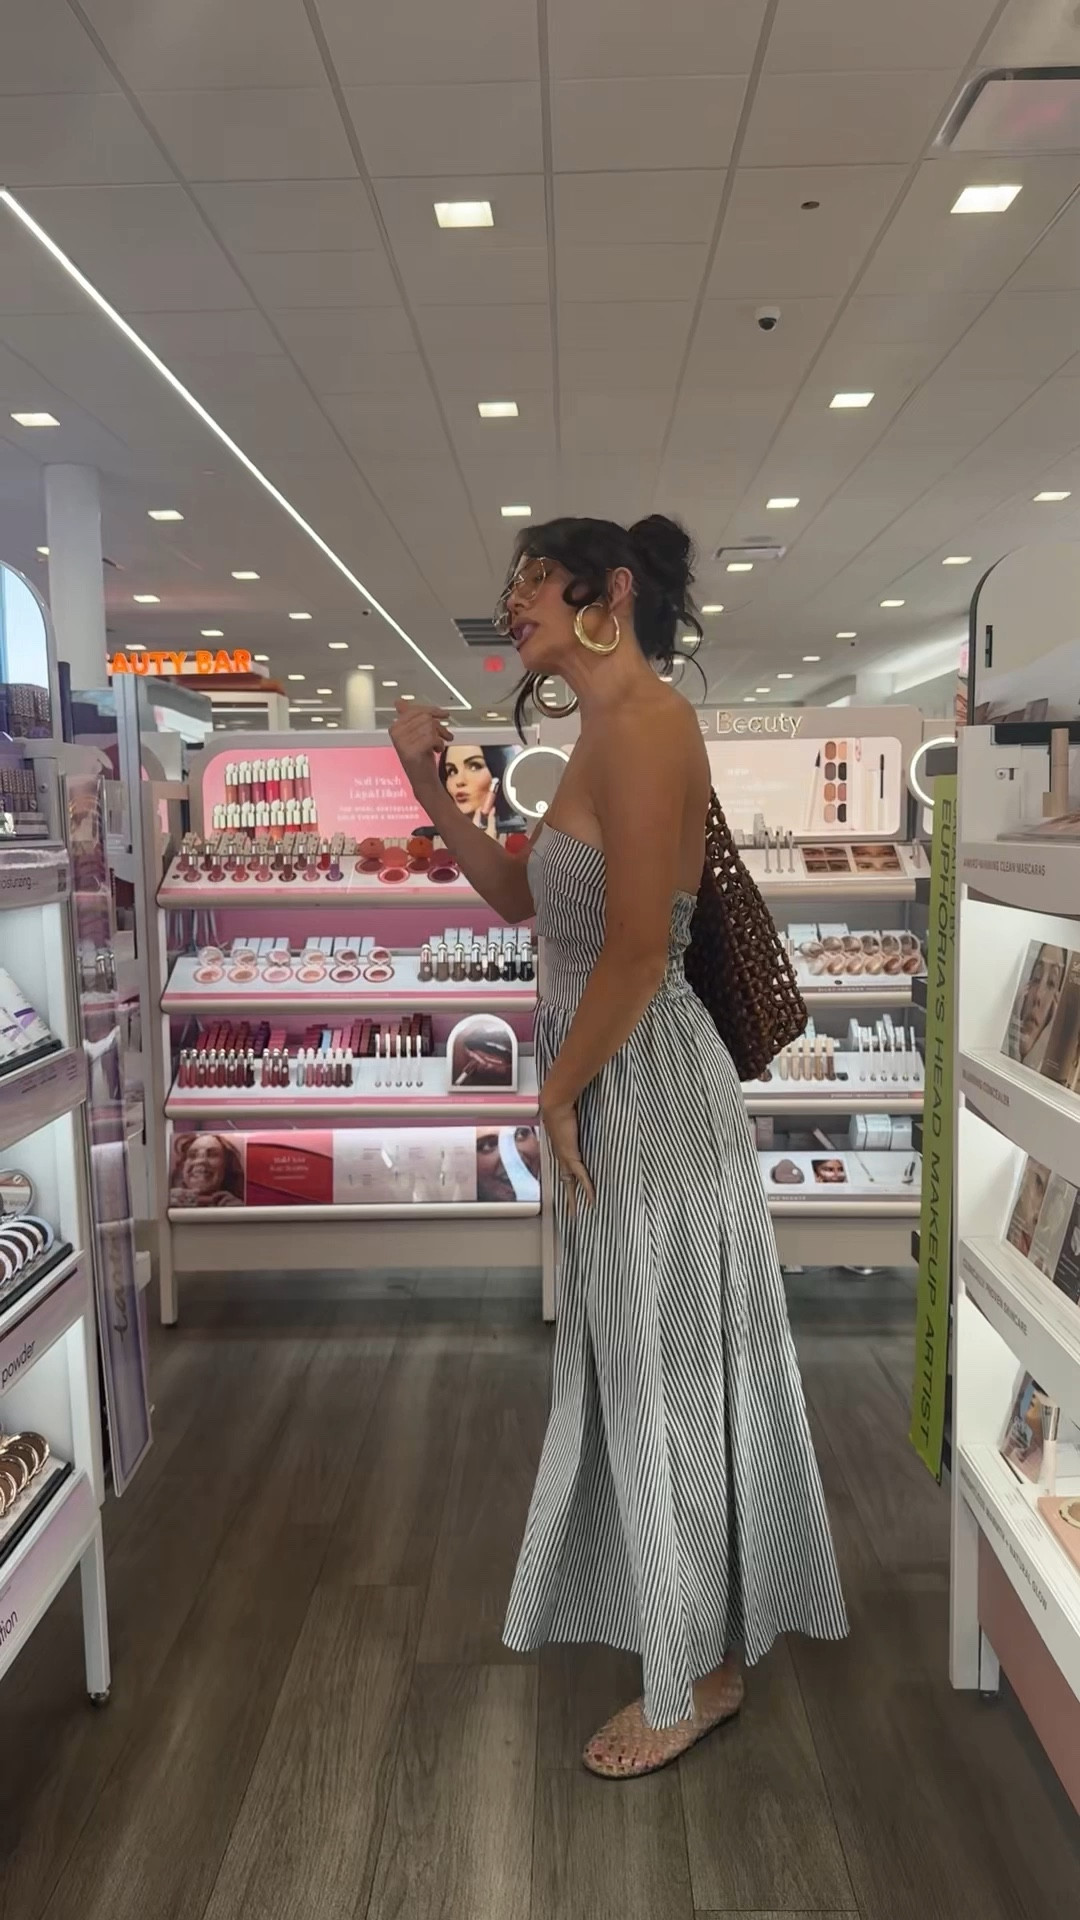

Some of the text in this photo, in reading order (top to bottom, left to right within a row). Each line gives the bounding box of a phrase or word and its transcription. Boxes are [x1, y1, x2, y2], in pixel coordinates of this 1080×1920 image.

[107, 649, 251, 675] AUTY BAR
[716, 710, 802, 738] Beauty
[920, 799, 951, 1448] EUPHORIA'S HEAD MAKEUP ARTIST
[2, 1340, 35, 1389] powder
[0, 1611, 18, 1646] tion
